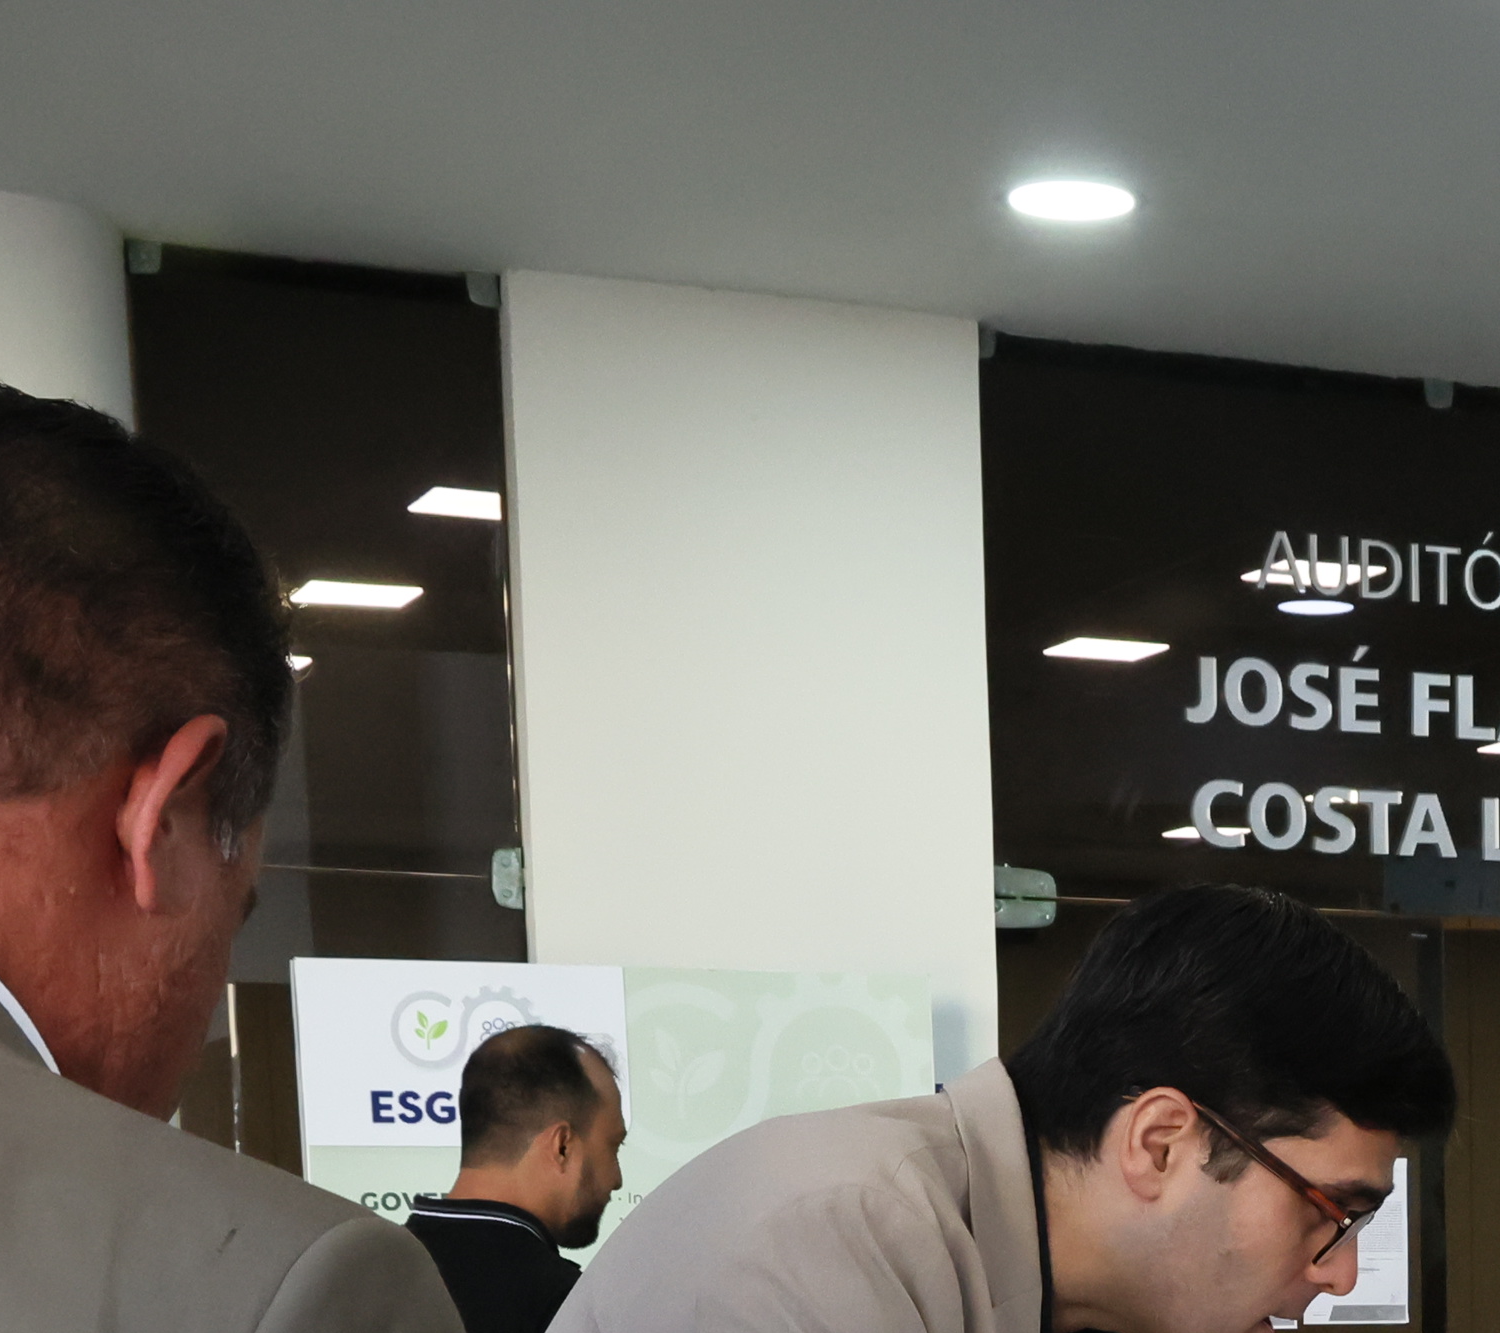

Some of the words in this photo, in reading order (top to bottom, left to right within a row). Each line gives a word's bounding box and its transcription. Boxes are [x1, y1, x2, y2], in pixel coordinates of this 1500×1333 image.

[1185, 645, 1382, 733] JOSÉ
[1191, 779, 1457, 861] COSTA
[370, 1090, 457, 1124] ESG
